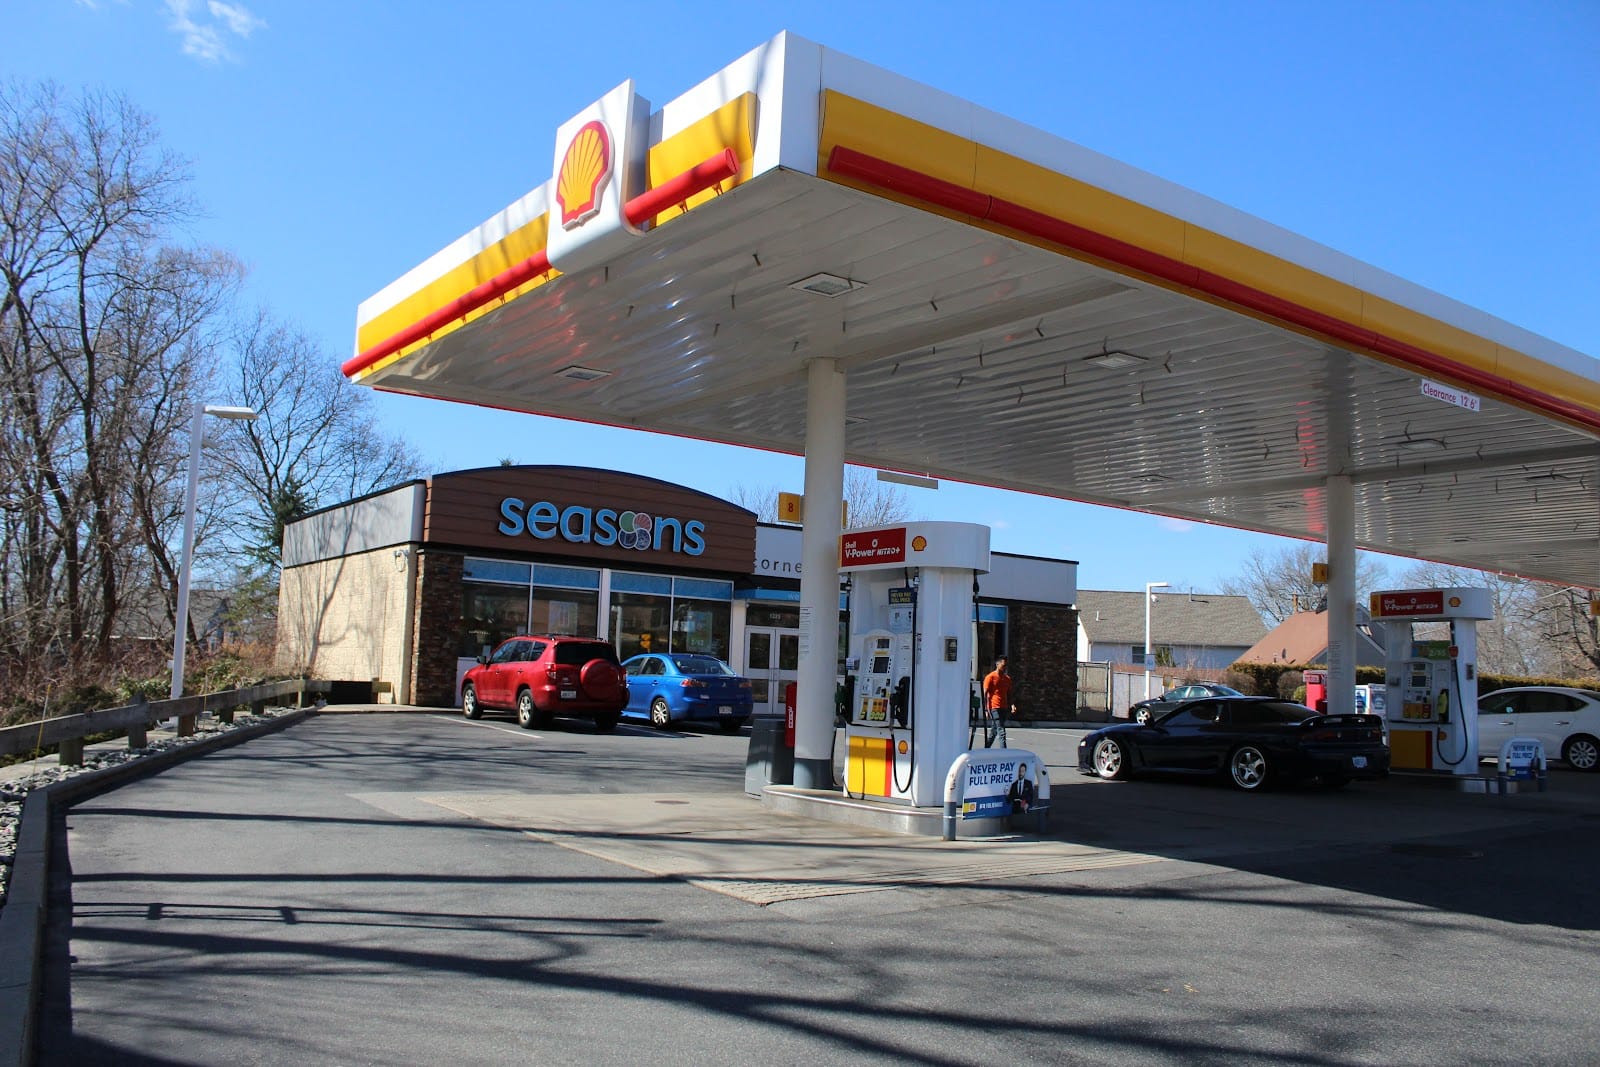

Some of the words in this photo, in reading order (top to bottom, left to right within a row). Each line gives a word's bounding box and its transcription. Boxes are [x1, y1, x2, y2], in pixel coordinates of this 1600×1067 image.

[1423, 383, 1457, 403] Clearance
[787, 502, 794, 513] 8
[498, 497, 706, 556] seasons
[845, 541, 857, 549] Shell
[845, 548, 875, 558] V-Power
[970, 764, 997, 775] NEVER
[999, 762, 1015, 772] PAY
[969, 776, 988, 786] FULL
[990, 774, 1013, 784] PRICE
